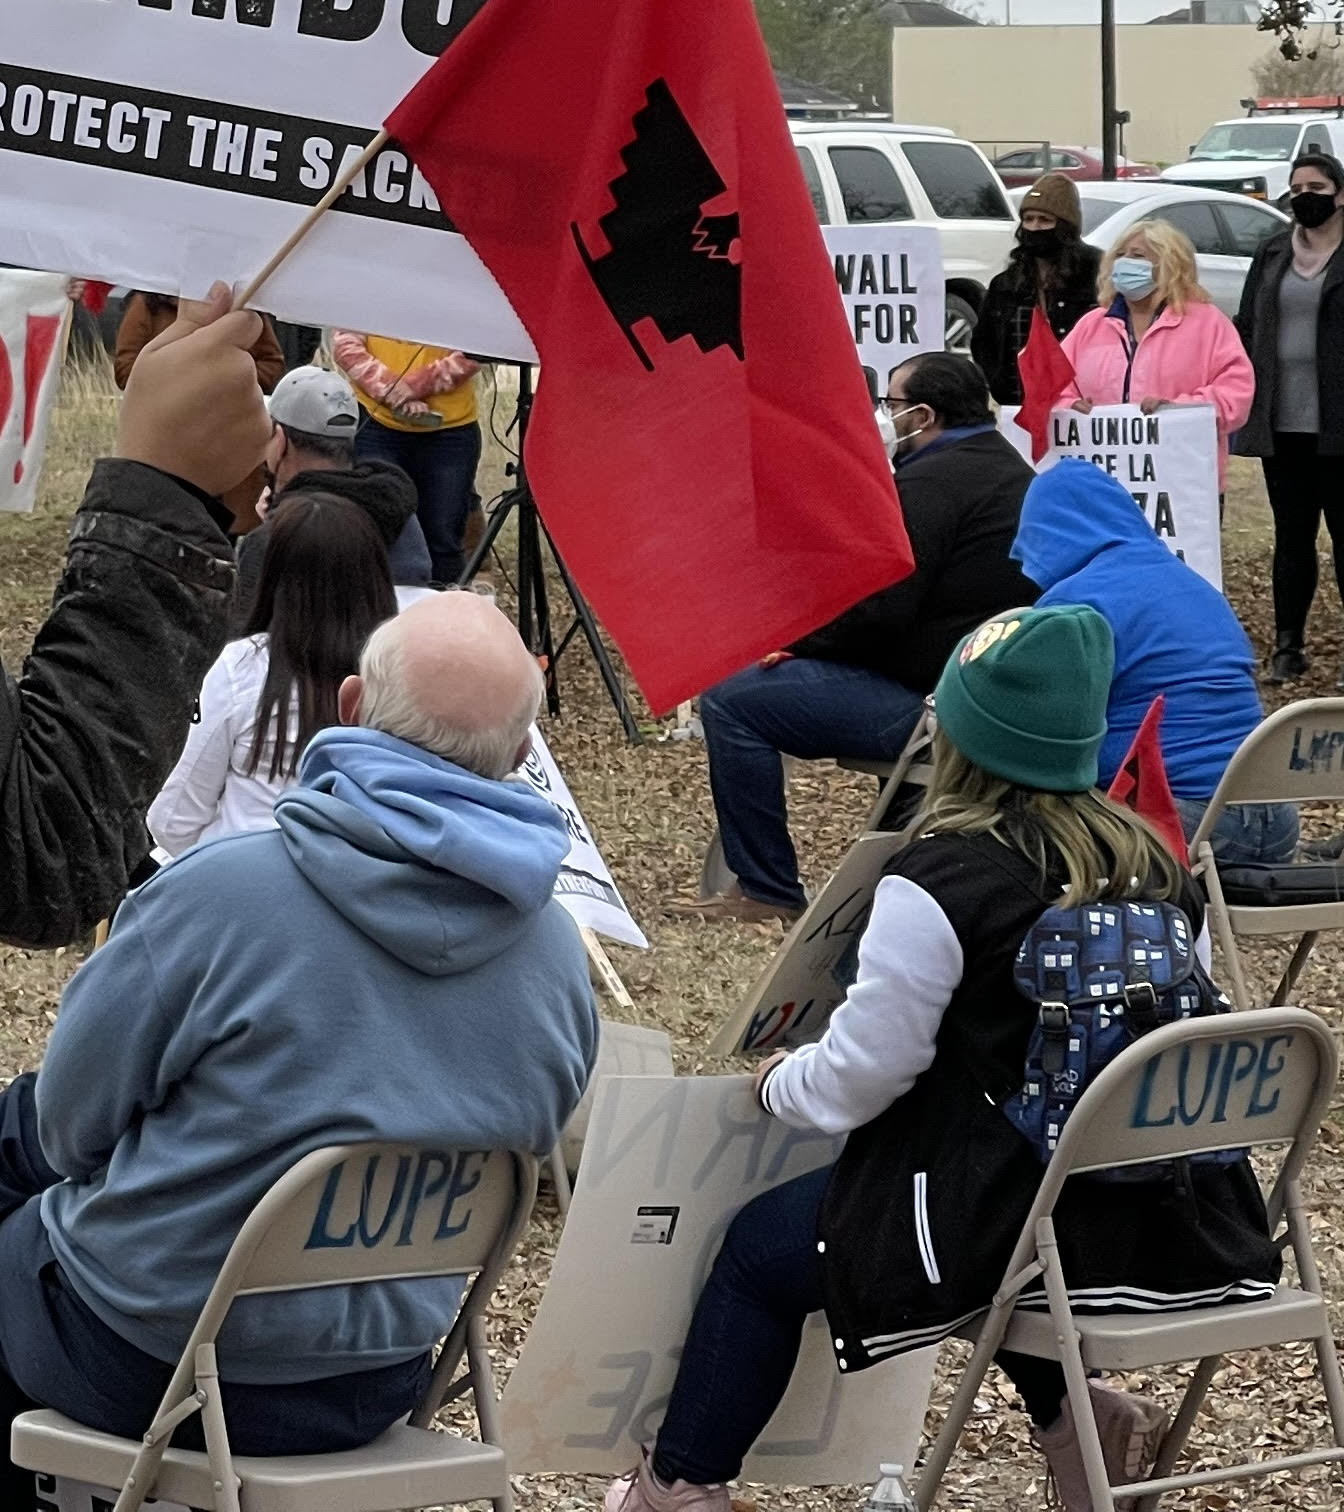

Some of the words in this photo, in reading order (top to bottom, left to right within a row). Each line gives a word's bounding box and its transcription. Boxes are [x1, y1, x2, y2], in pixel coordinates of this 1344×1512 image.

[186, 114, 283, 182] THE
[853, 303, 920, 345] FOR
[1054, 418, 1081, 447] LA
[1091, 417, 1160, 446] UNION
[1128, 453, 1157, 482] LA
[1129, 1034, 1295, 1129] LUPE
[303, 1150, 493, 1251] LUPE
